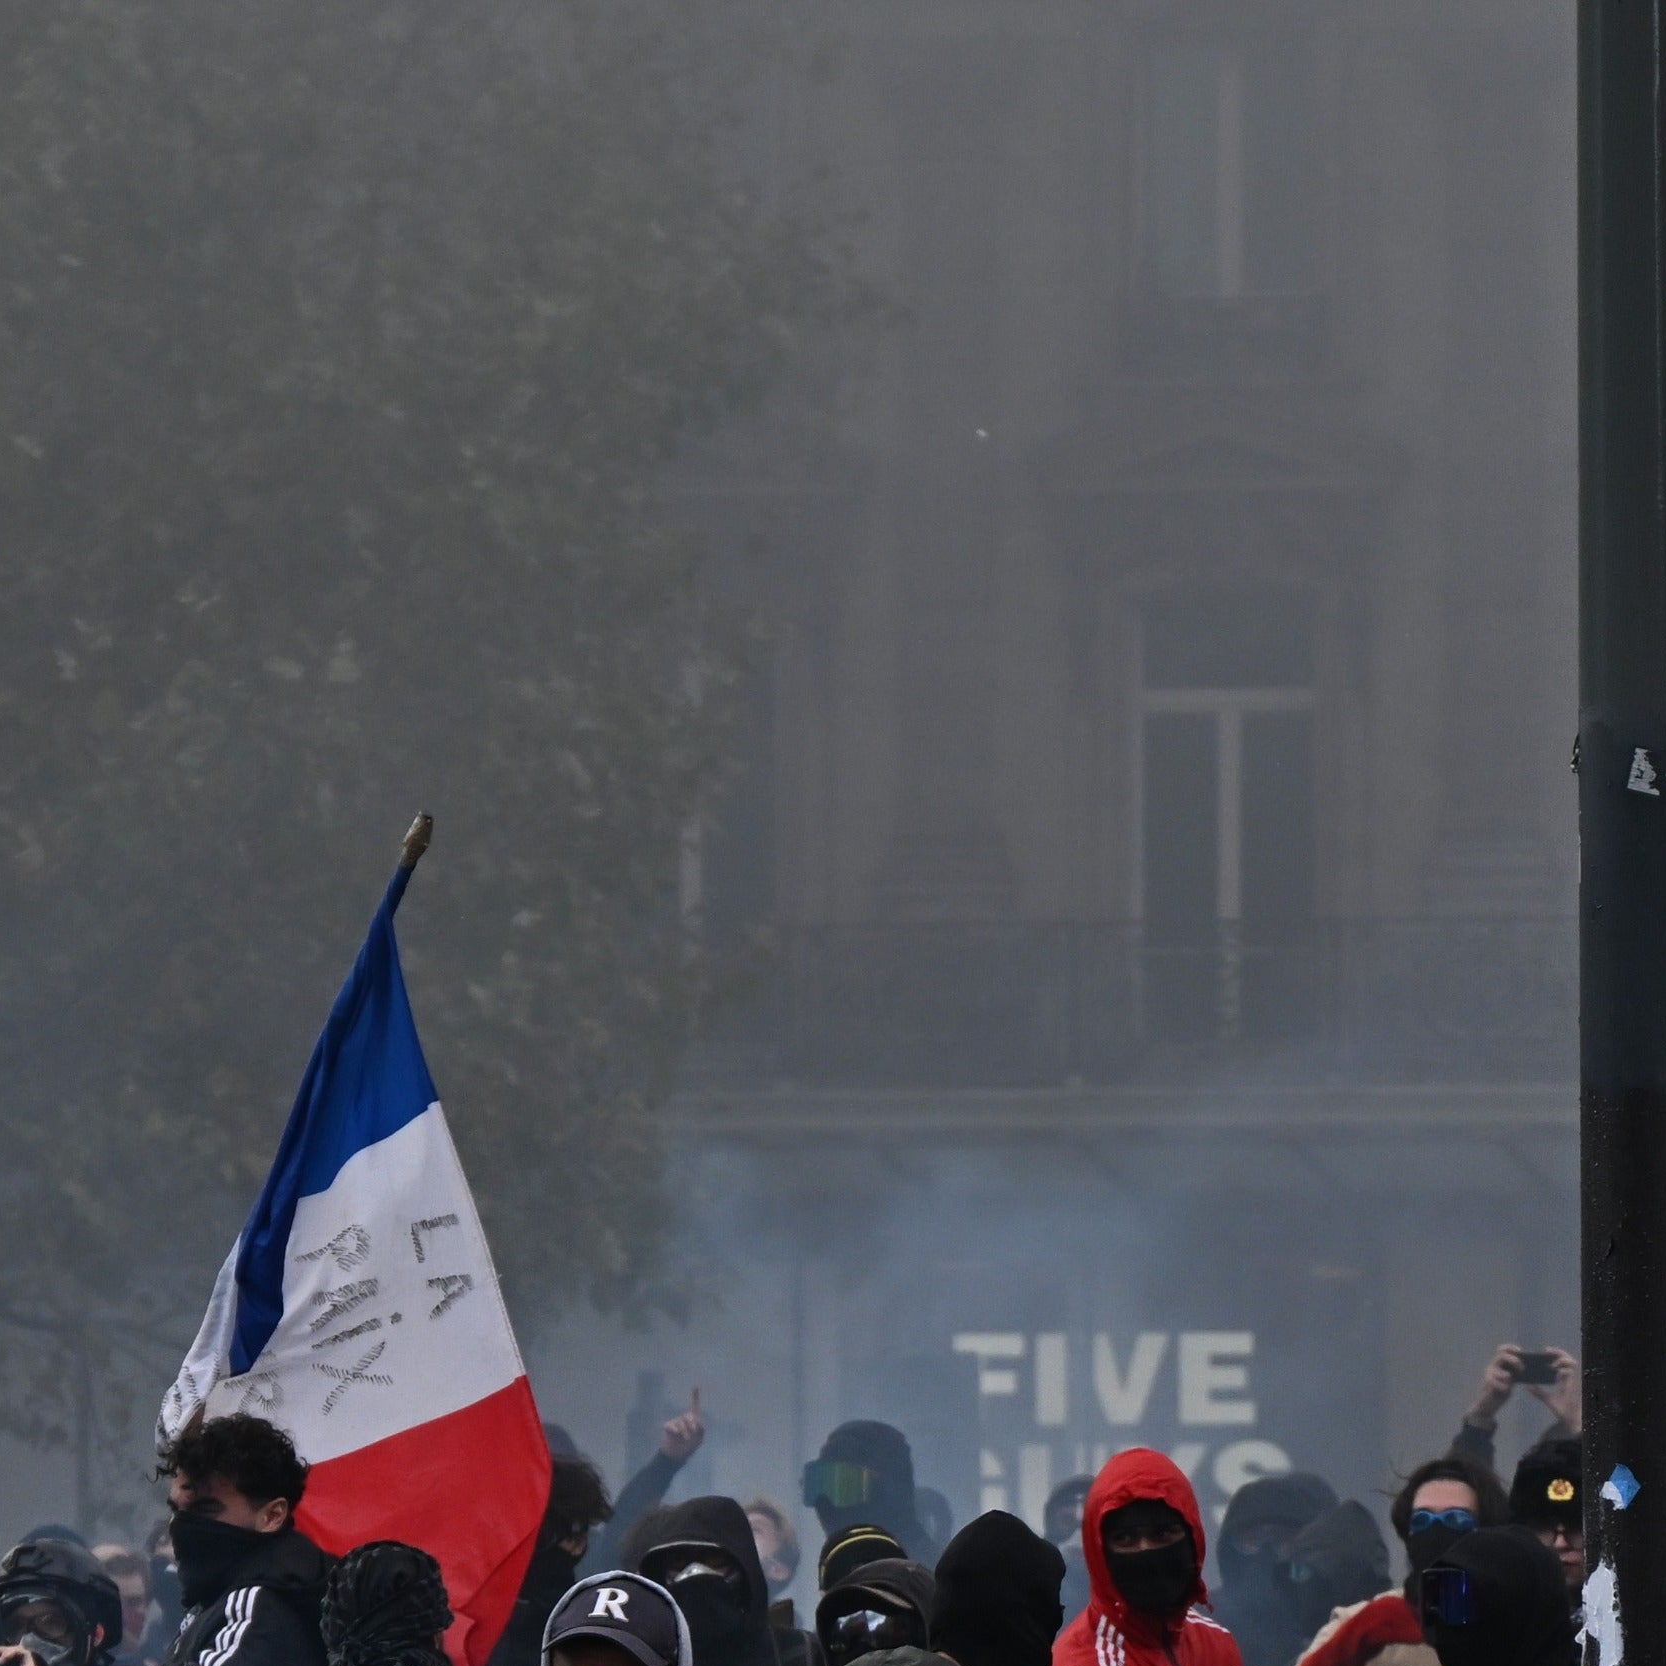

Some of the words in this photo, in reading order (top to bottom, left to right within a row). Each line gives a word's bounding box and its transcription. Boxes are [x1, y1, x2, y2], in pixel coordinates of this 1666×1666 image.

[410, 1213, 473, 1321] LA
[951, 1331, 1259, 1427] FIVE
[587, 1587, 630, 1623] R
